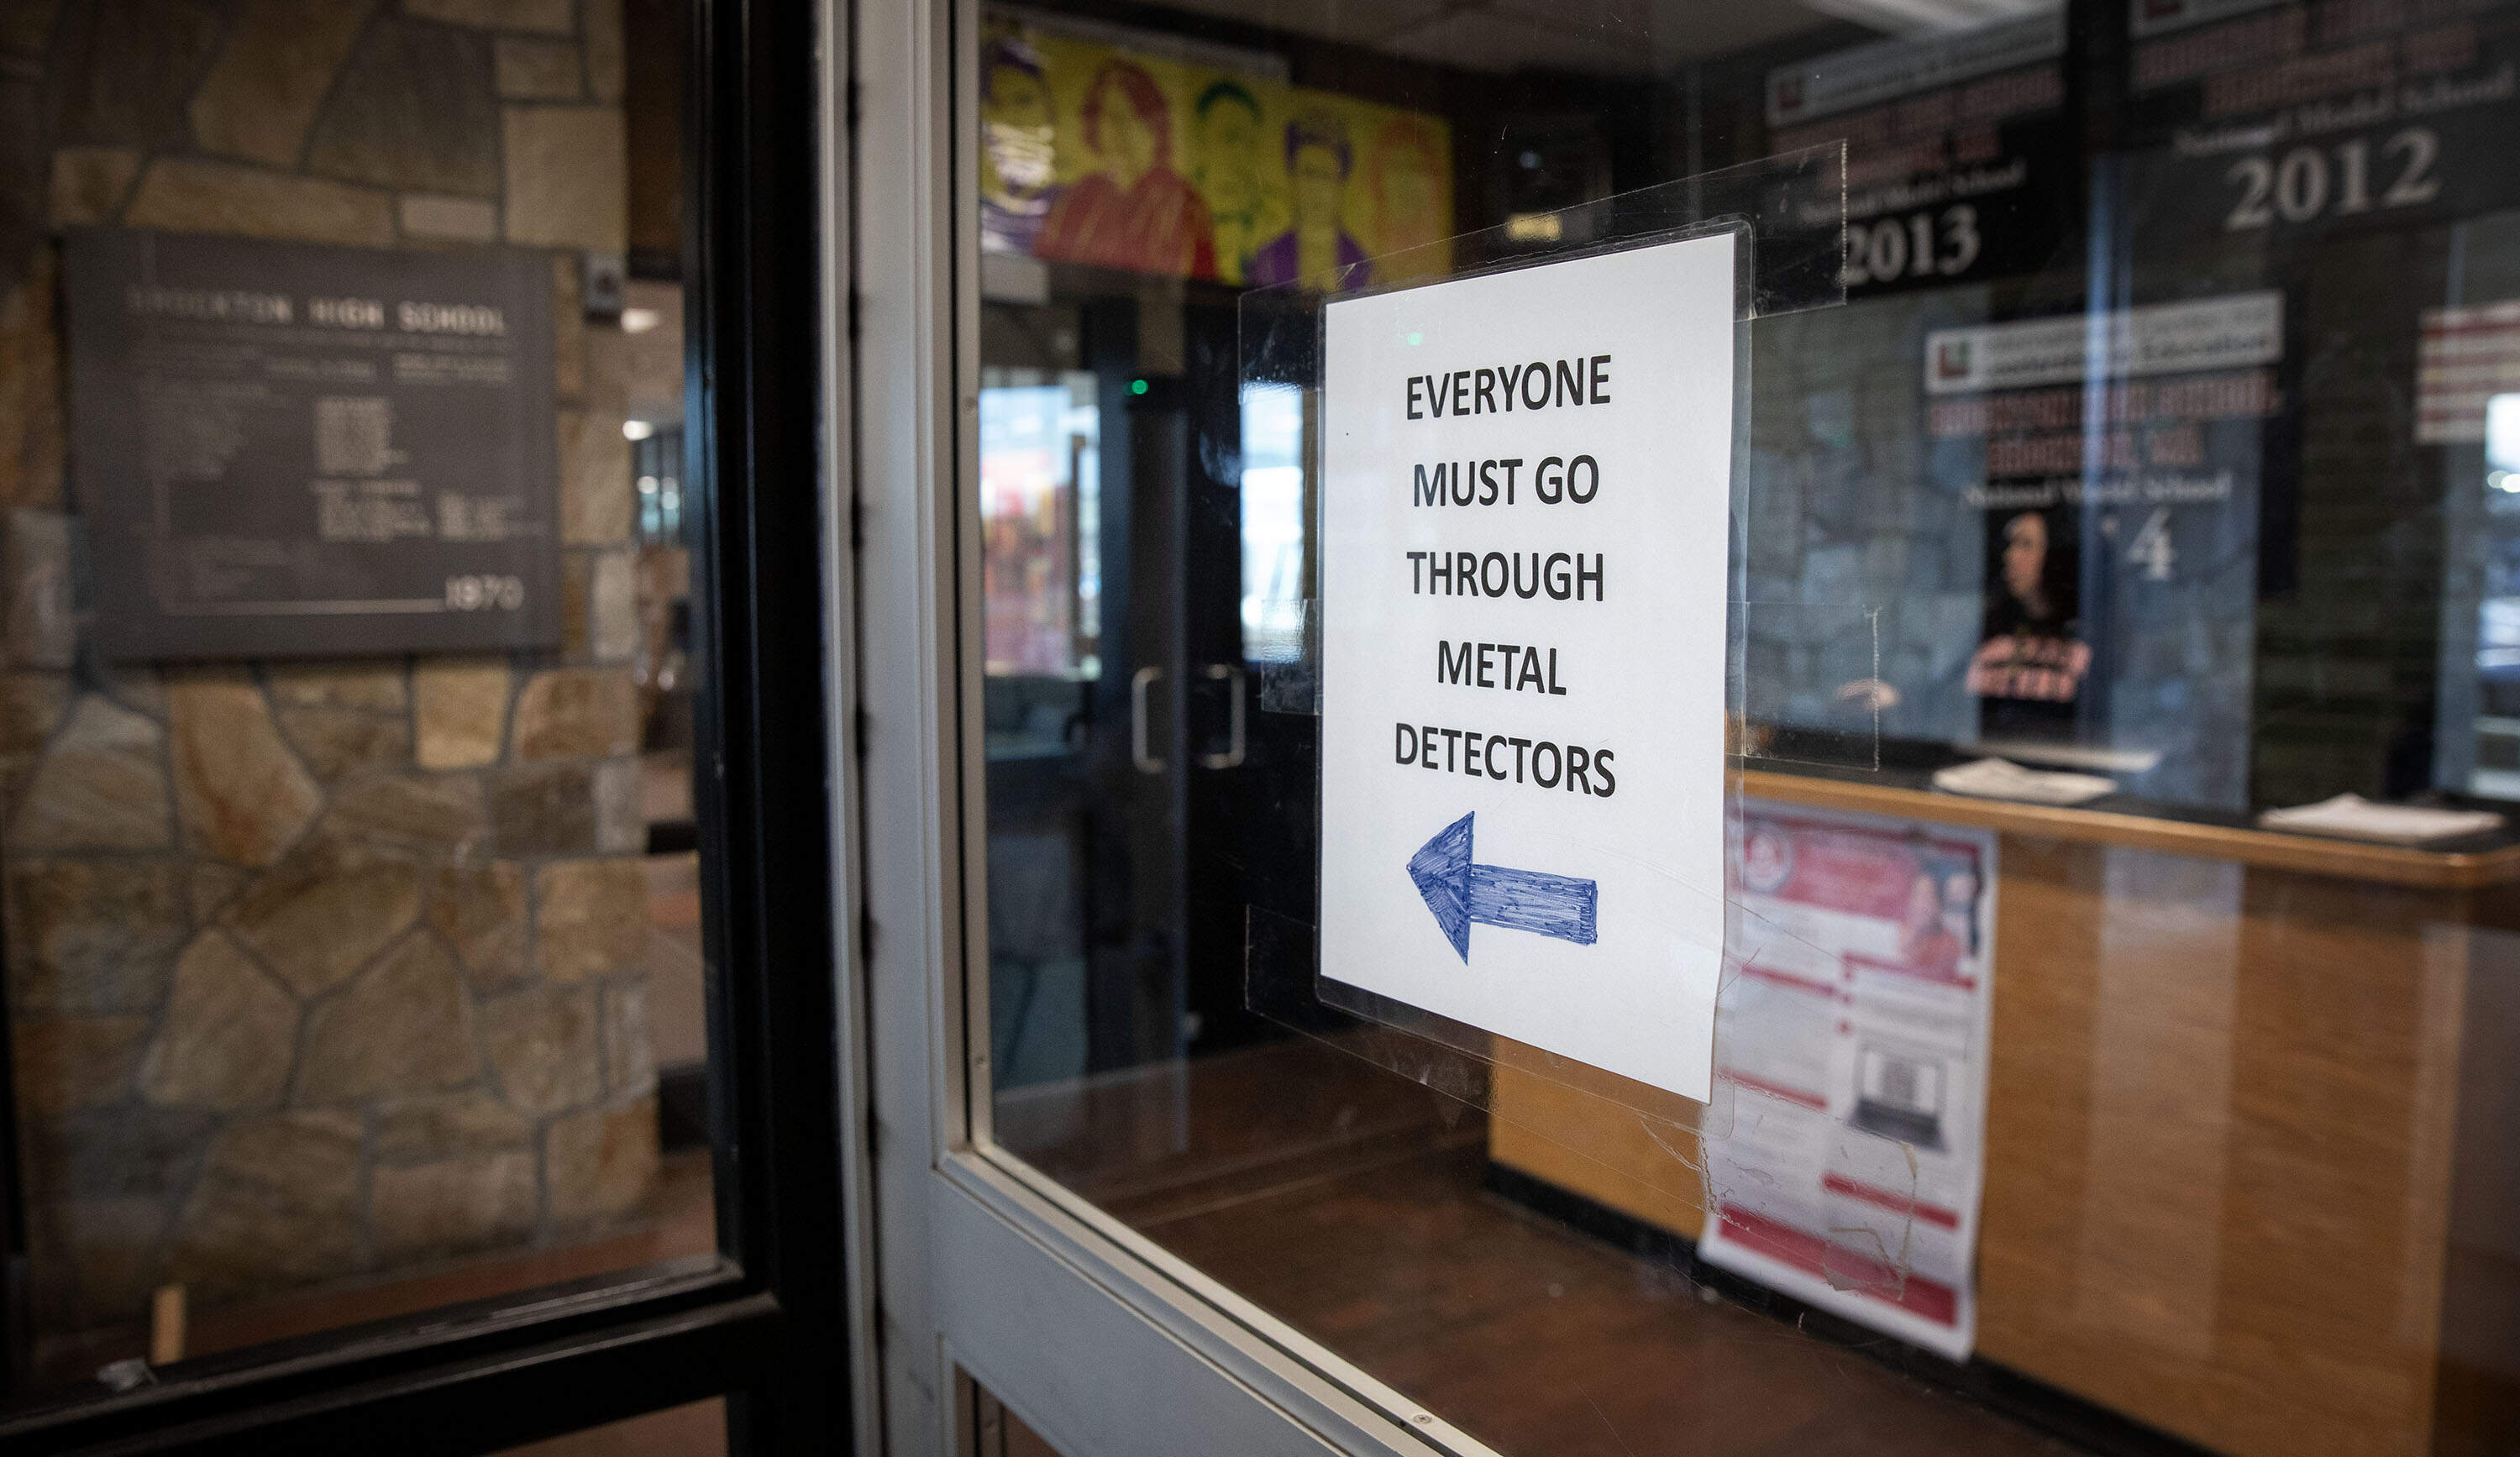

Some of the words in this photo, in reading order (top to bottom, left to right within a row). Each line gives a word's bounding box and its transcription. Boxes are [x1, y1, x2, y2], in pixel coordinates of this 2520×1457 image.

[2224, 126, 2443, 232] 2012
[1835, 204, 1981, 286] 2013
[1406, 354, 1611, 420] EVERYONE
[1414, 459, 1523, 507] MUST
[1535, 454, 1599, 505] GO
[1406, 551, 1604, 602] THROUGH
[1437, 640, 1567, 696] METAL
[1395, 722, 1616, 798] DETECTORS
